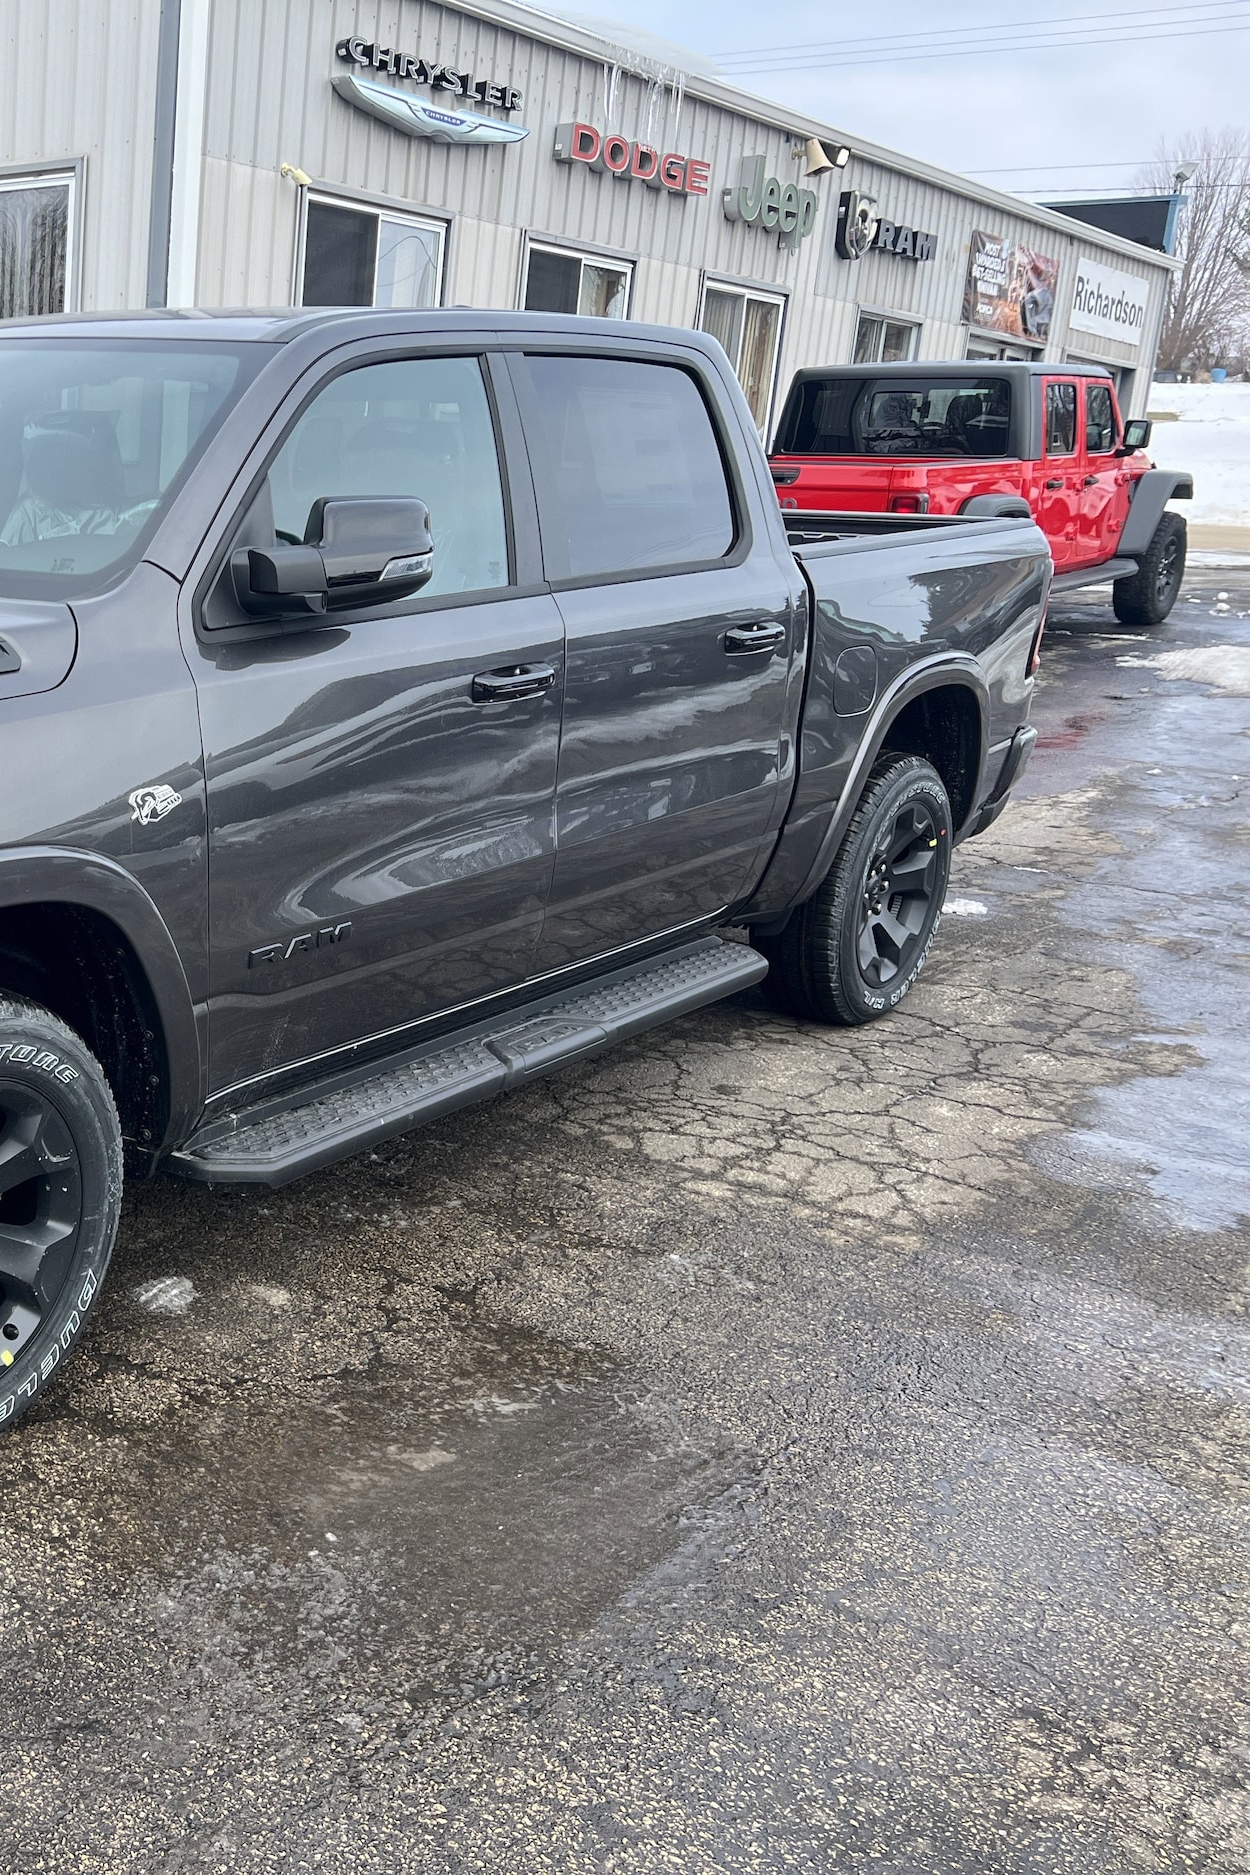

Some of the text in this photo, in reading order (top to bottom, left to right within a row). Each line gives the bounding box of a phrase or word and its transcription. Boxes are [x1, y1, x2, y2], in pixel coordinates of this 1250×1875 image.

[344, 35, 525, 112] CHRYSLER
[572, 122, 711, 197] DODGE
[734, 155, 818, 242] Jeep
[877, 219, 938, 262] RAM
[1073, 275, 1145, 329] Richardson
[247, 921, 352, 969] RAM
